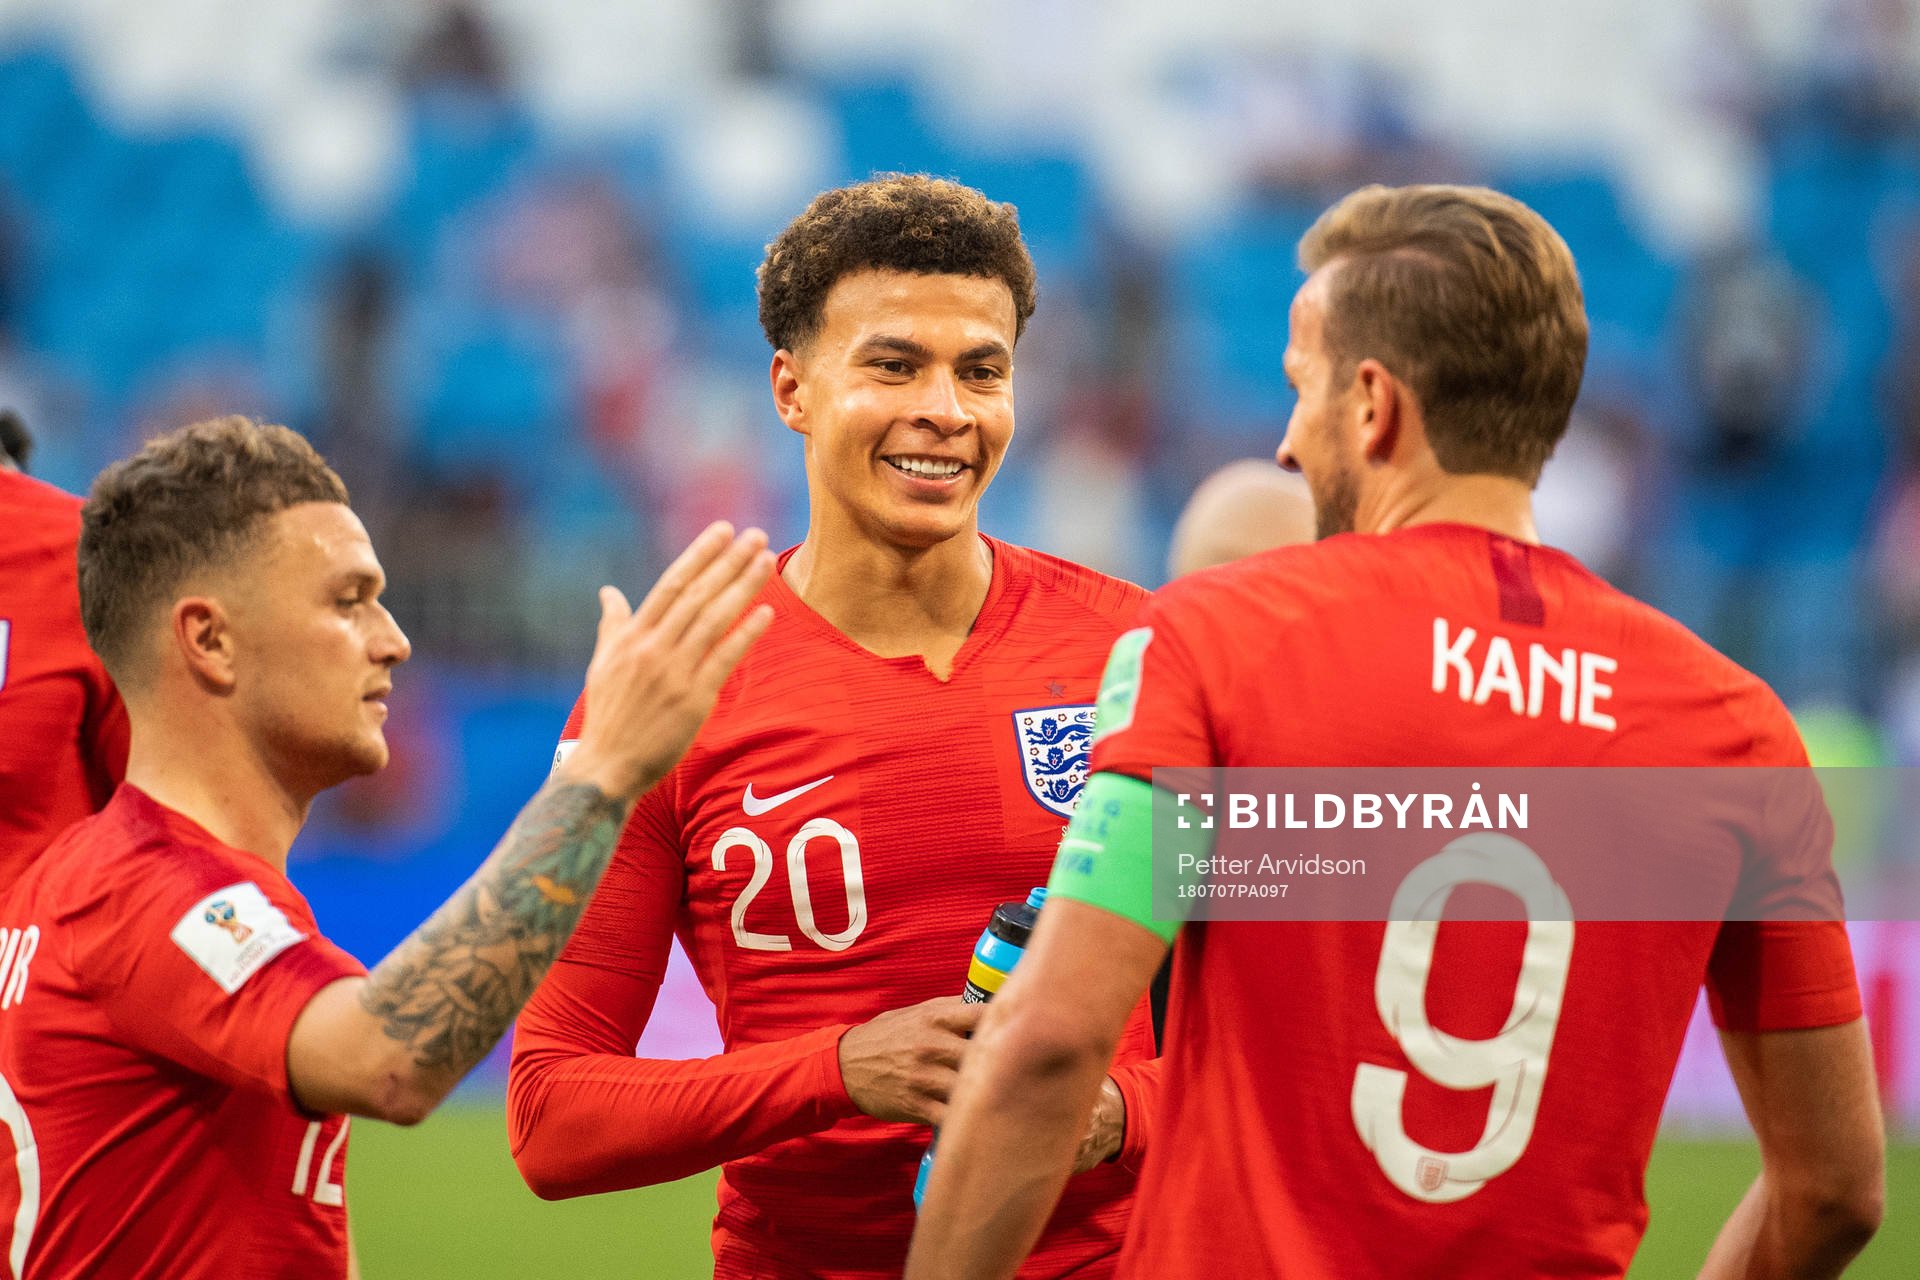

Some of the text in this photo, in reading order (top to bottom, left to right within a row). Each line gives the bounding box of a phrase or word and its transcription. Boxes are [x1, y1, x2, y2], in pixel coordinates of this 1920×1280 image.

[1432, 617, 1618, 731] KANE
[711, 817, 868, 952] 20
[1351, 830, 1575, 1204] 9
